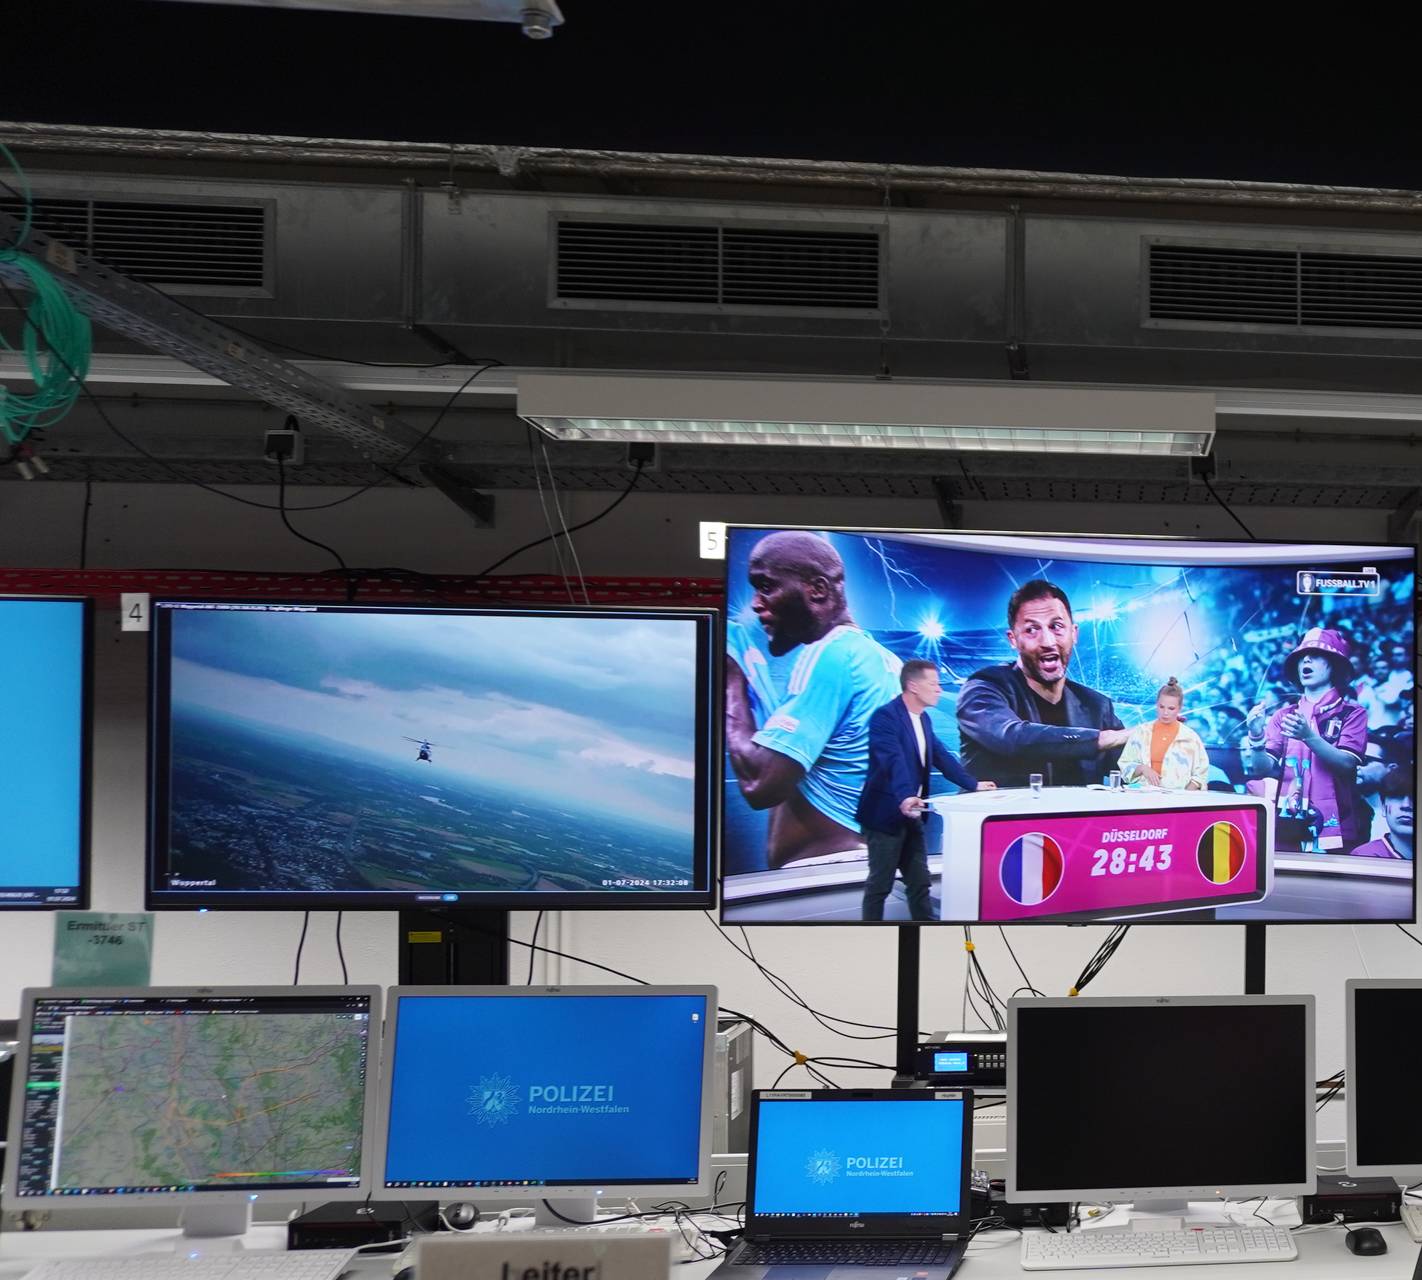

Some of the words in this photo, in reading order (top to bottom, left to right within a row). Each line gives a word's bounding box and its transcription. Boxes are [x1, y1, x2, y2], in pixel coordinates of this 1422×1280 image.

[707, 531, 718, 551] 5
[128, 603, 143, 623] 4
[1102, 828, 1168, 843] DÜSSELDORF
[1091, 844, 1173, 876] 28:43
[170, 879, 217, 887] Wuppertal
[128, 920, 147, 931] ST
[88, 935, 123, 945] -3746
[529, 1085, 614, 1102] POLIZEI
[528, 1105, 629, 1114] Nordrhein-Westfalen
[847, 1157, 903, 1169] POLIZEI
